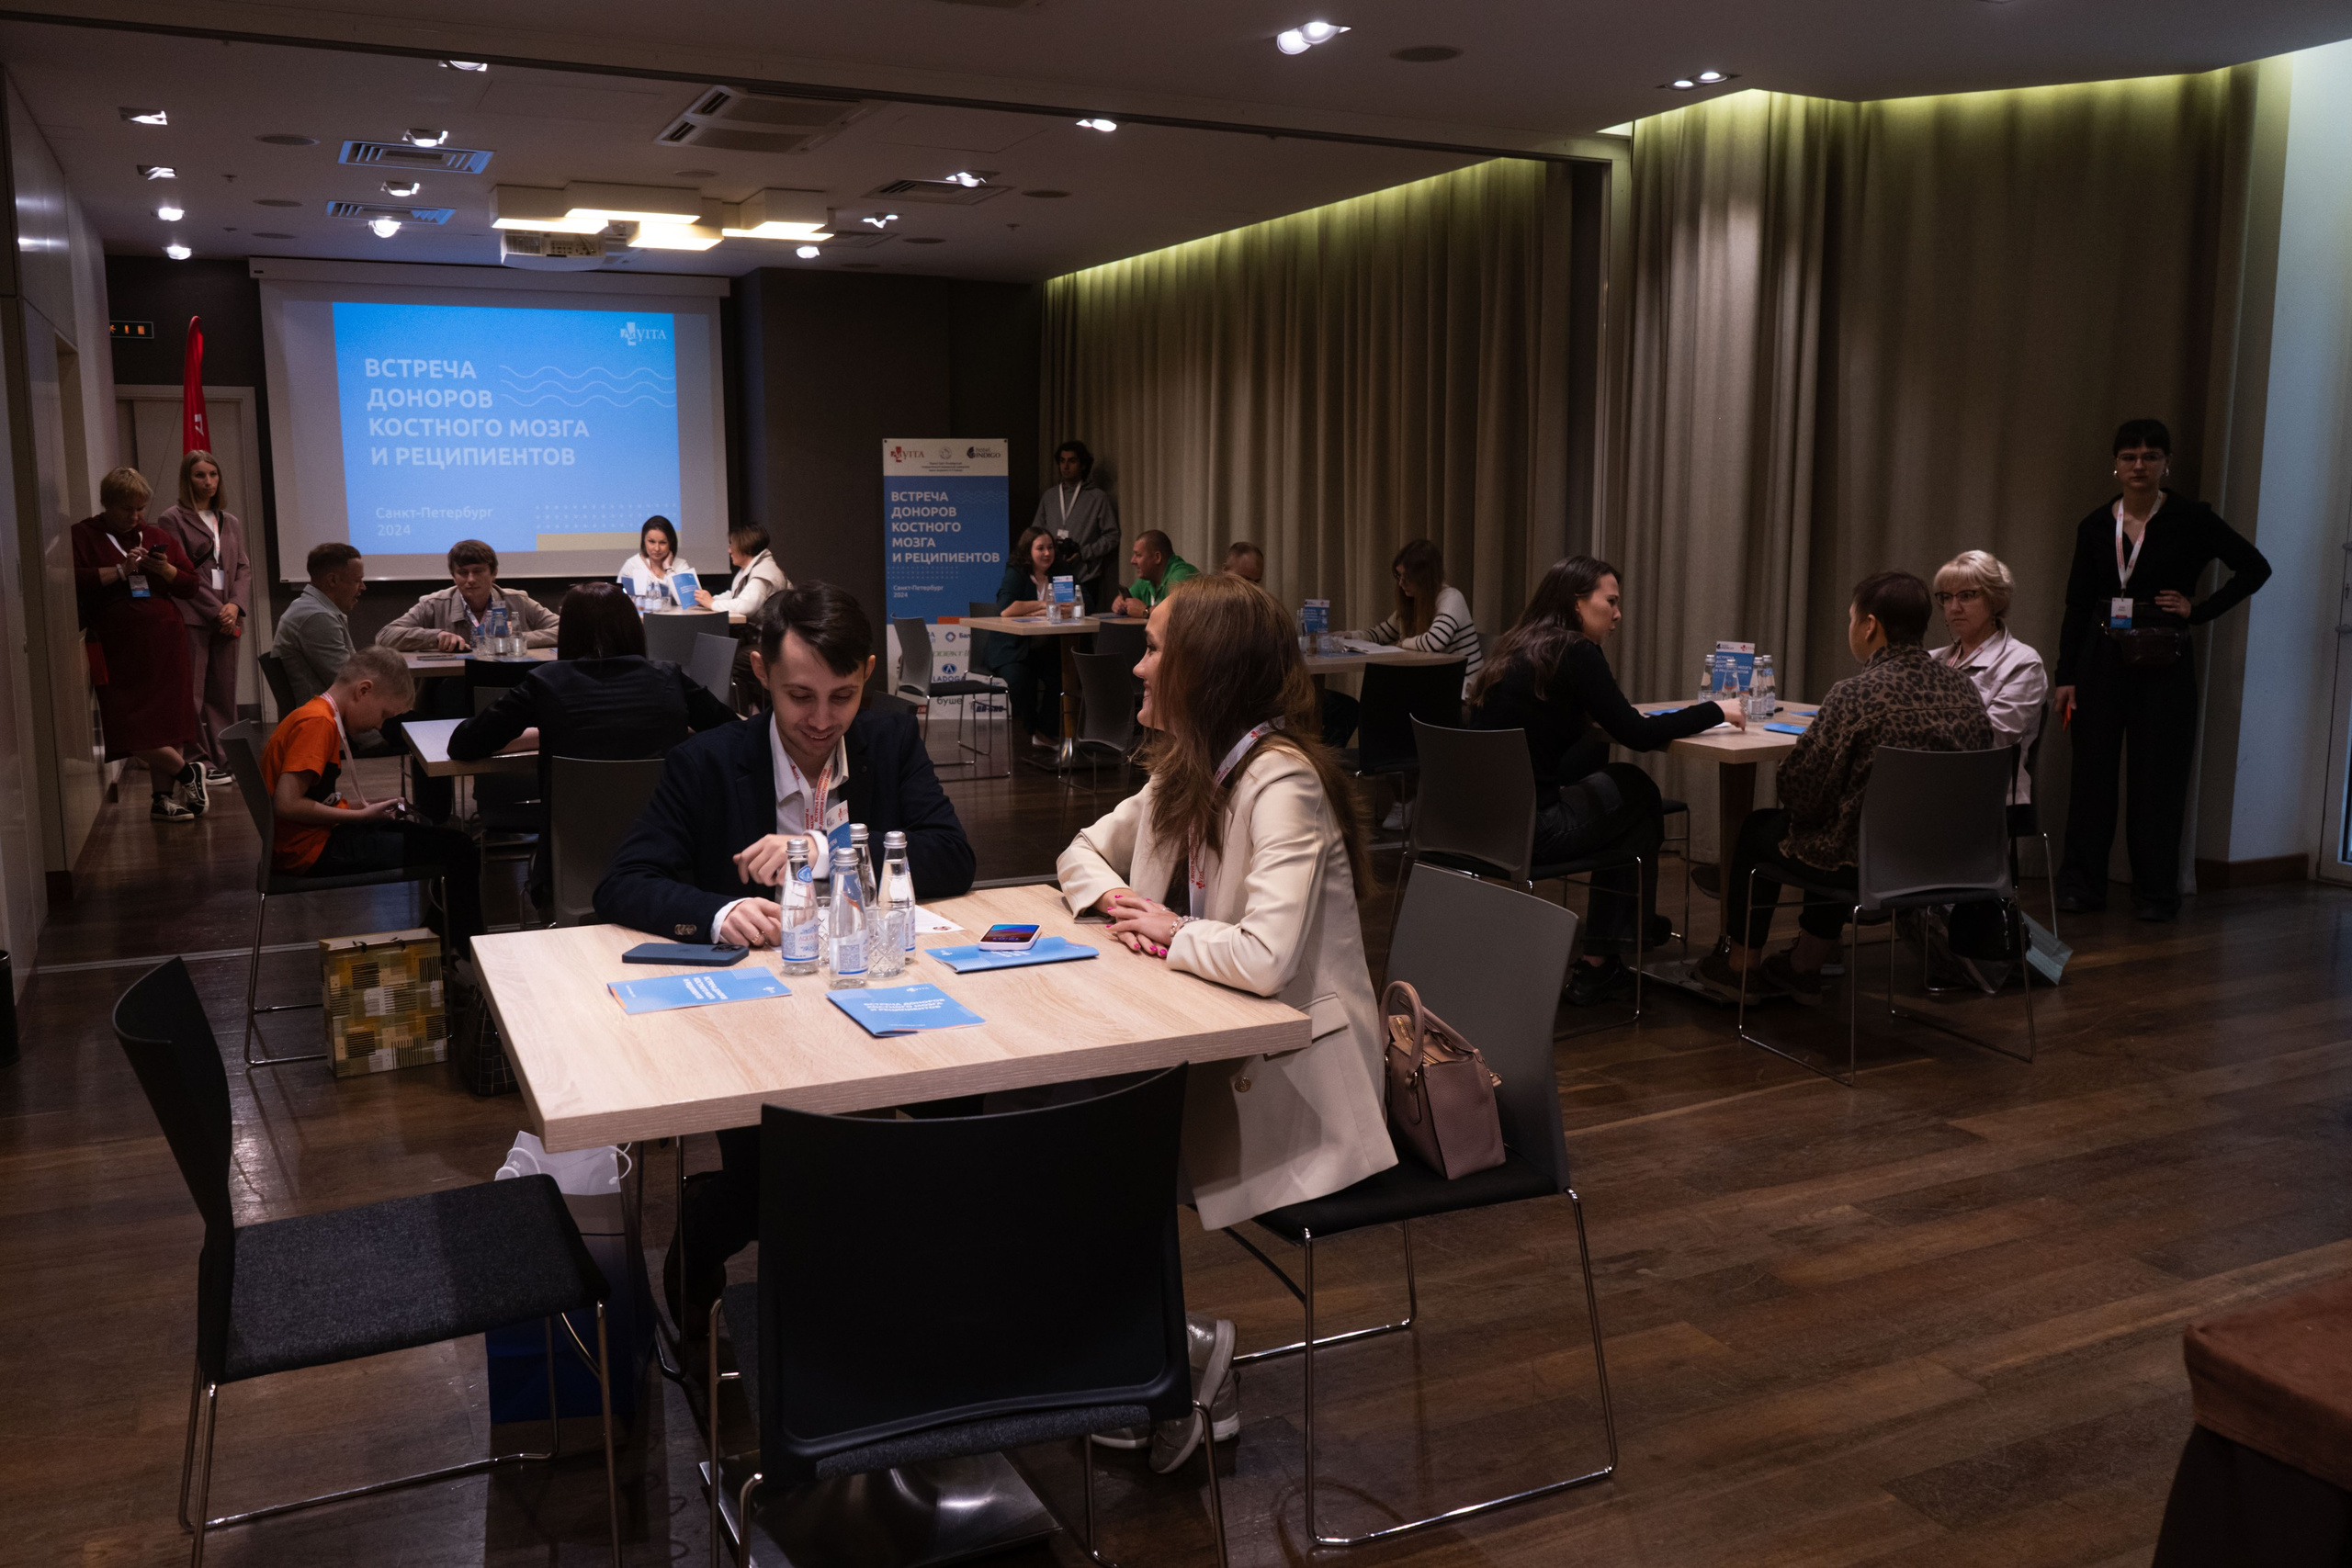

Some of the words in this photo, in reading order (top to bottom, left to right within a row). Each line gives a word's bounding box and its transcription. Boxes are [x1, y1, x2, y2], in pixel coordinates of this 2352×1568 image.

[365, 358, 477, 379] ВСТРЕЧА
[367, 388, 493, 412] ДОНОРОВ
[369, 418, 503, 438] КОСТНОГО
[509, 419, 590, 438] МОЗГА
[371, 446, 388, 466] И
[395, 446, 575, 470] РЕЦИПИЕНТОВ
[891, 491, 949, 502] ВСТРЕЧА
[376, 506, 493, 521] Санкт-Петербург
[891, 507, 957, 519] ДОНОРОВ
[378, 524, 412, 536] 2024
[891, 522, 961, 533] КОСТНОГО
[892, 537, 936, 547] МОЗГА
[892, 553, 902, 563] И
[904, 553, 1001, 564] РЕЦИПИЕНТОВ
[893, 584, 944, 592] Санкт-Петербург
[936, 696, 963, 706] буше
[816, 768, 827, 801] РЕЦИПИЕНТОВ
